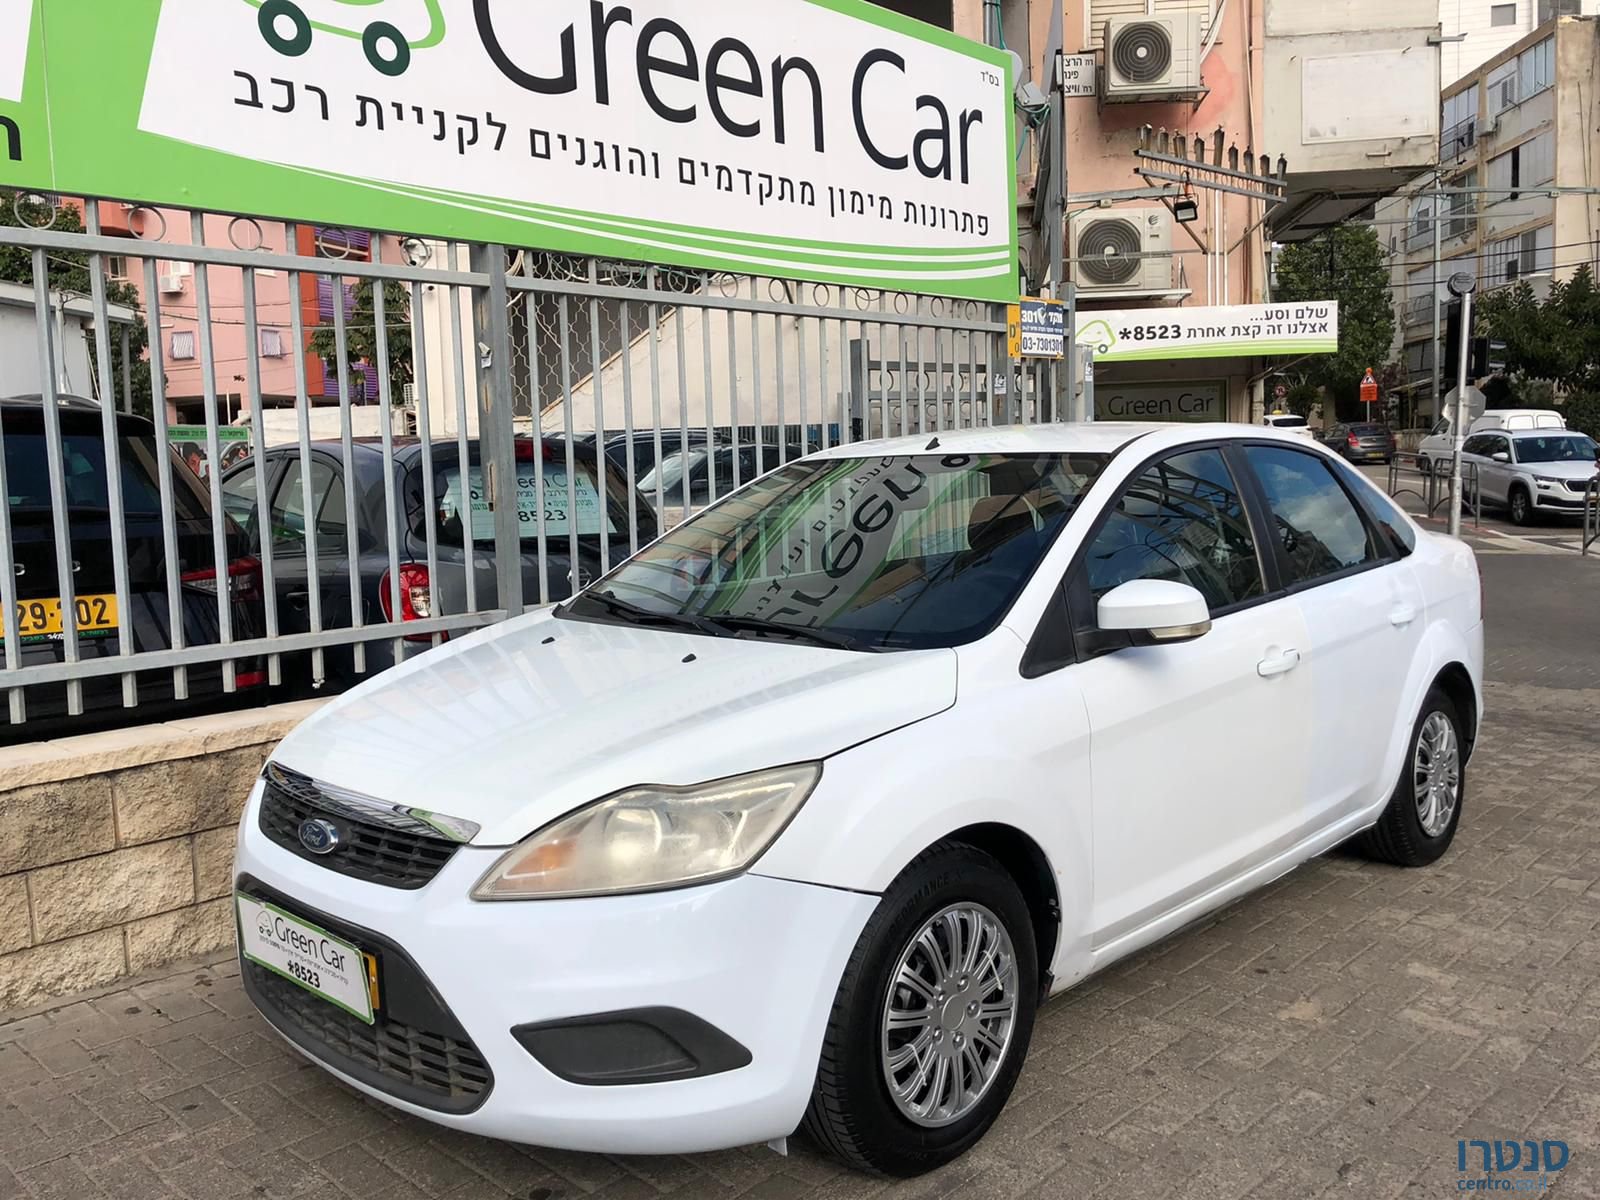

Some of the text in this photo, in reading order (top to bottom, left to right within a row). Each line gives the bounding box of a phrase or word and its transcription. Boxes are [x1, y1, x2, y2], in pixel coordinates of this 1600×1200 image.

[473, 0, 982, 184] Green Car
[234, 70, 989, 236] פתרונות מימון מתקדמים והוגנים לקניית רכב
[1021, 310, 1038, 323] 301
[1250, 306, 1328, 321] שלם וסע...
[1186, 326, 1226, 339] אחרת
[1231, 325, 1261, 339] קצת
[1266, 324, 1283, 335] זה
[1287, 321, 1328, 334] אצלנו
[1108, 393, 1214, 416] Green Car
[275, 916, 318, 958] Green
[320, 939, 345, 972] Car
